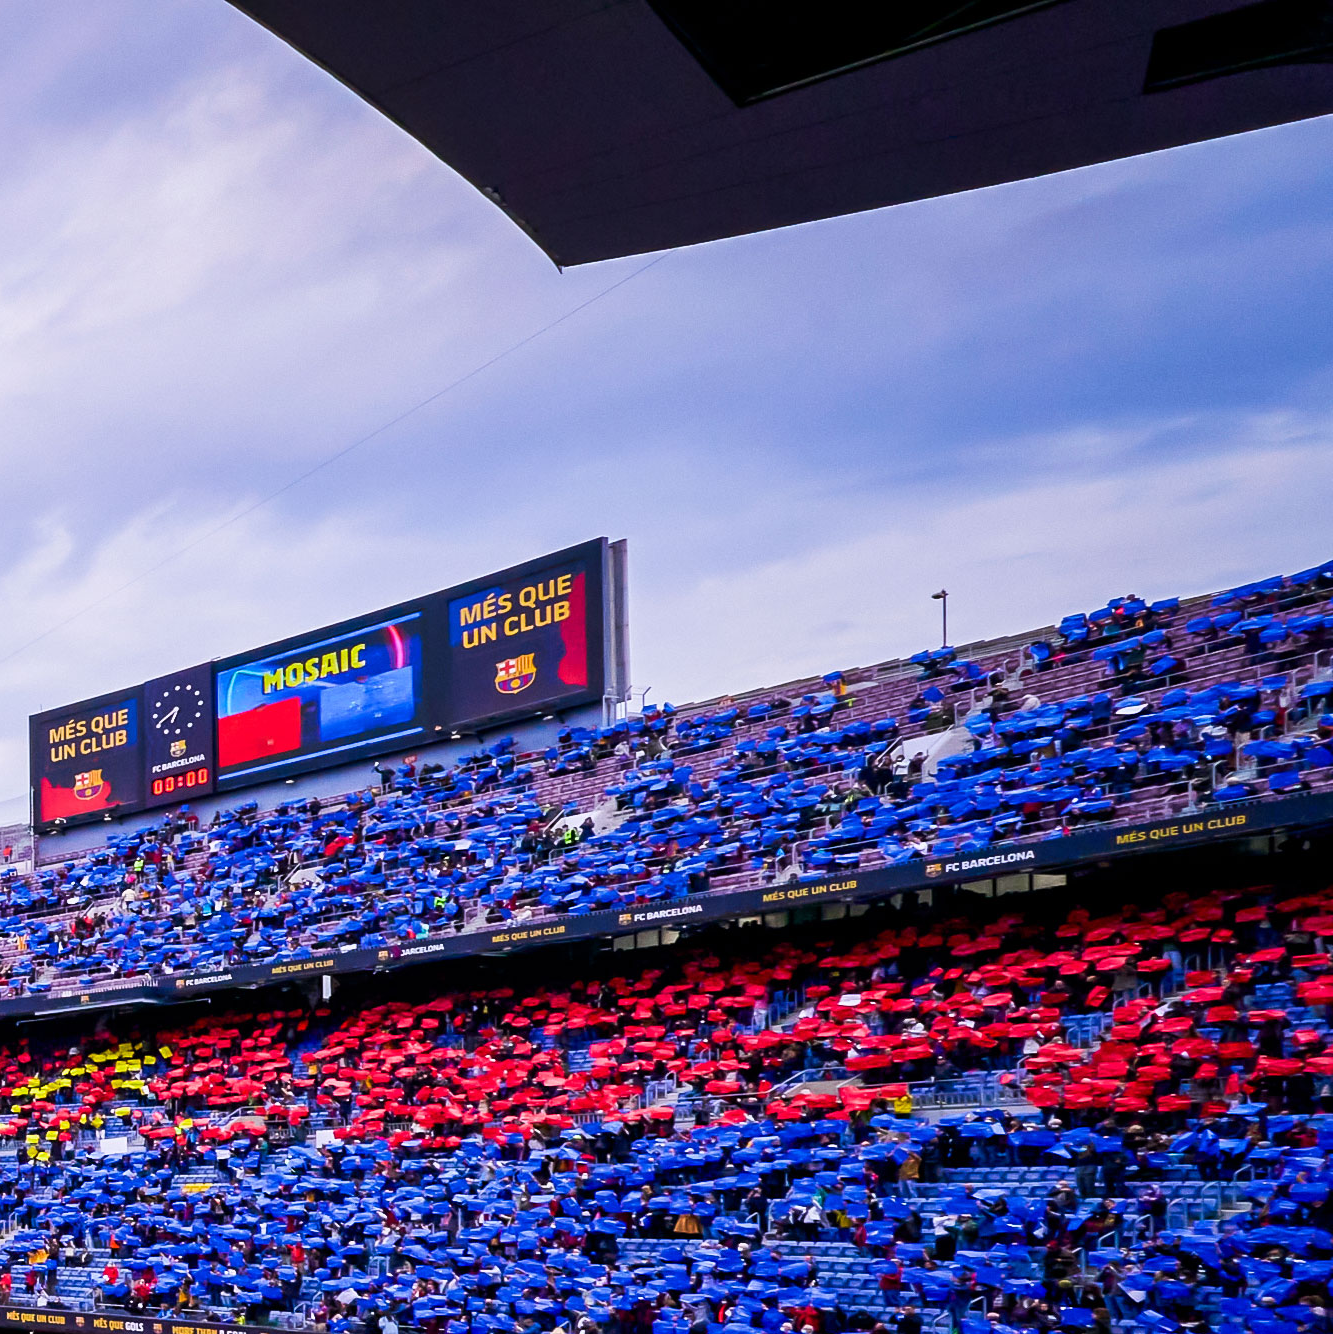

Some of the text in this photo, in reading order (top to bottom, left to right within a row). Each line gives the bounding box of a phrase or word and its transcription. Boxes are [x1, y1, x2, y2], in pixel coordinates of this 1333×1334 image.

[460, 573, 572, 627] MÉS QUE
[462, 600, 570, 649] UN CLUB
[263, 643, 366, 694] MOSAIC
[49, 708, 129, 744] MÉS QUE
[50, 730, 128, 763] UN CLUB
[152, 753, 205, 774] FC BARCELONA
[152, 768, 209, 796] 00:00
[1116, 814, 1246, 846] MÉS QUE UN CLUB
[945, 849, 1035, 873] FC BARCELONA
[762, 880, 857, 903] MÉS QUE UN CLUB
[634, 904, 703, 922] FC BARCELONA
[491, 926, 565, 943] MÉS QUE UN CLUB
[272, 959, 334, 974] MÉS QUE UN CLUB
[185, 973, 233, 986] FC BARCELONA
[6, 1310, 66, 1325] MÉS QUE UN CLUB
[93, 1317, 144, 1332] MÉS QUE GOLS
